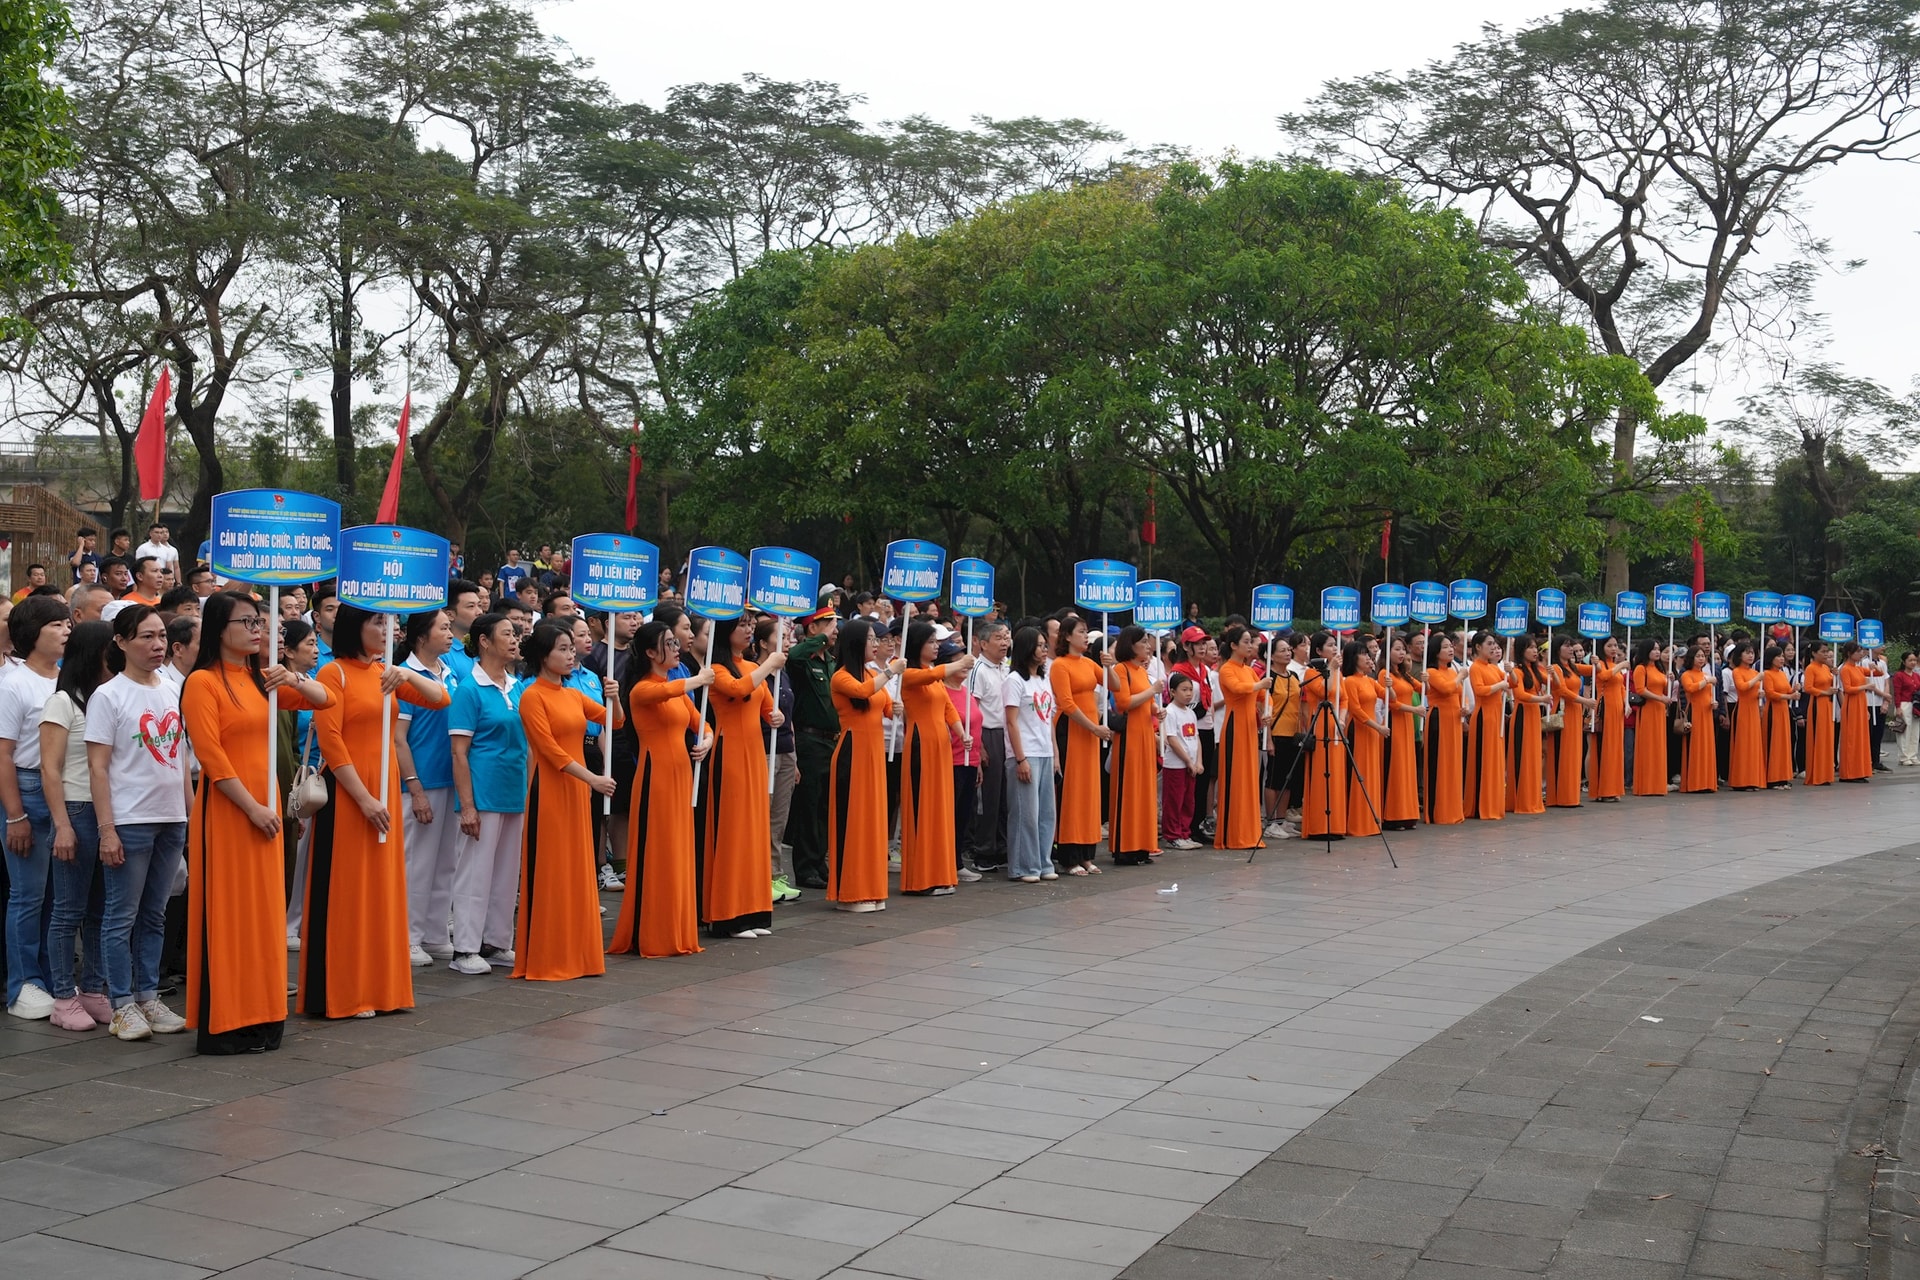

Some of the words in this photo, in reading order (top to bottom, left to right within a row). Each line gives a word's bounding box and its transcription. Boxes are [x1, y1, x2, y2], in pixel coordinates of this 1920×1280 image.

[220, 530, 235, 546] CÁN
[238, 530, 247, 550] BỘ
[250, 531, 269, 548] CÔNG
[272, 532, 292, 550] CHỨC,
[295, 533, 310, 549] VIÊN
[312, 534, 332, 551] CHỨC,
[232, 551, 254, 568] NGƯỜI
[256, 555, 269, 569] LAO
[272, 553, 291, 571] ĐỘNG
[293, 554, 321, 570] PHƯỜNG
[384, 559, 402, 579] HỘI
[590, 562, 603, 580] HỘI
[605, 564, 622, 579] LIÊN
[624, 566, 641, 583] HIỆP
[770, 575, 785, 588] ĐOÀN
[888, 565, 904, 586] CÔNG
[904, 569, 914, 587] AN
[914, 567, 938, 588] PHƯỜNG
[342, 580, 359, 598] CỰU
[362, 578, 386, 597] CHIẾN
[389, 584, 408, 598] BINH
[411, 583, 444, 600] PHƯỜNG
[584, 583, 599, 598] PHỤ
[602, 583, 613, 597] NỮ
[615, 584, 646, 599] PHƯỜNG
[691, 575, 706, 600] CÔNG
[707, 578, 722, 602] ĐOÀN
[722, 581, 742, 605] PHƯỜNG
[1079, 579, 1087, 600] TỔ
[1088, 582, 1101, 600] DÂN
[1102, 581, 1114, 601] PHỐ
[1116, 581, 1124, 601] SỐ
[1125, 587, 1133, 601] 20
[776, 593, 789, 605] MINH
[790, 594, 810, 608] PHƯỜNG
[1137, 602, 1143, 621] TỔ
[1144, 604, 1154, 620] DÂN
[1156, 602, 1164, 620] PHỐ
[1166, 602, 1172, 620] SỐ
[1173, 606, 1178, 620] 19
[1261, 605, 1269, 620] DÂN
[1280, 603, 1285, 621] SỐ
[1347, 605, 1352, 621] SỐ
[1353, 609, 1358, 621] 17
